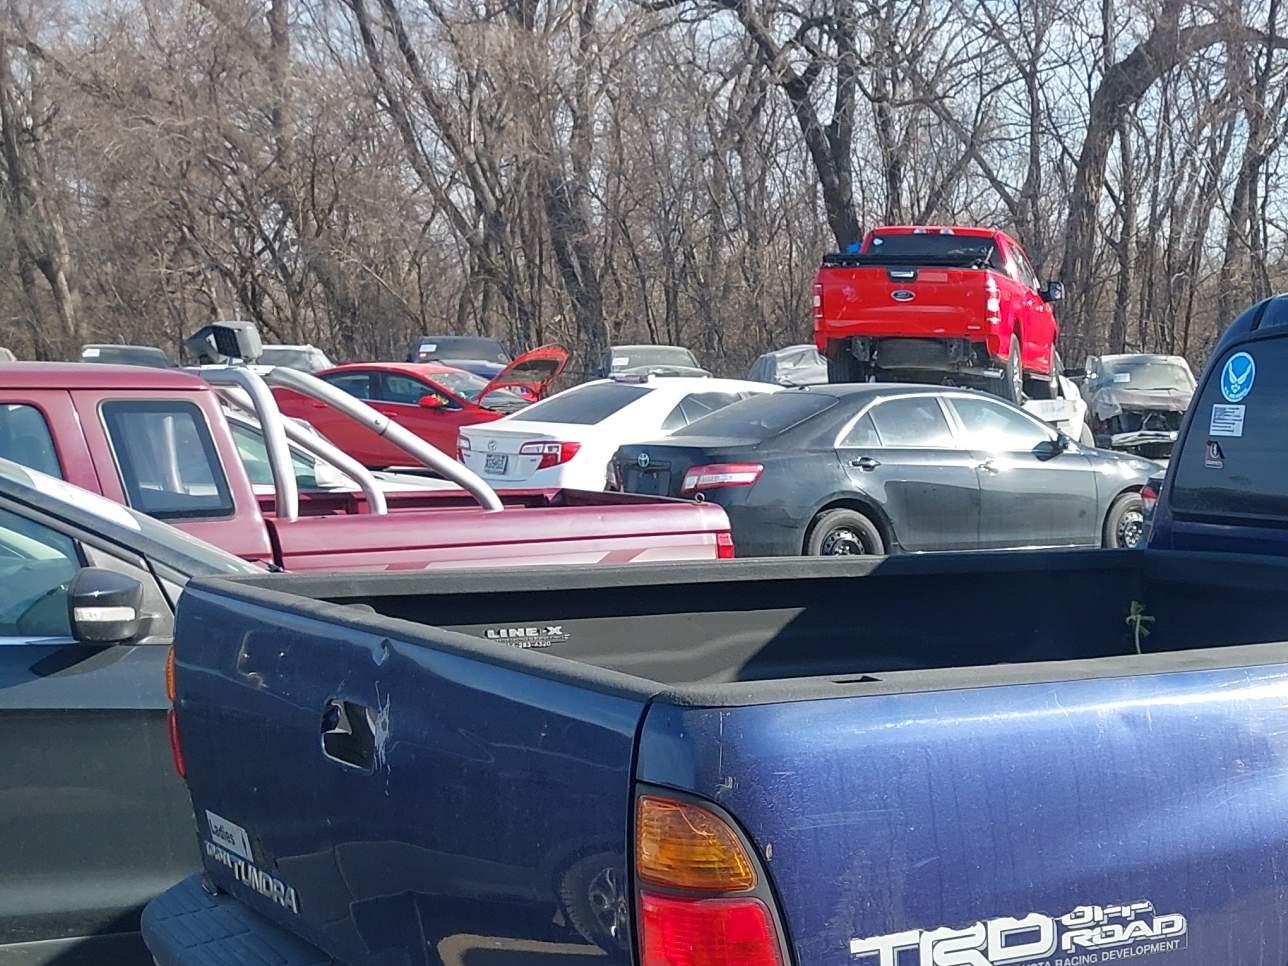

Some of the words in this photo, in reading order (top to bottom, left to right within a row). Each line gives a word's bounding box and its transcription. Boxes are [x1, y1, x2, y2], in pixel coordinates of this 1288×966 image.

[485, 626, 563, 639] LINE-X
[231, 856, 299, 914] TUNDRA
[1061, 900, 1154, 929] OFF
[1061, 912, 1187, 953] ROAD
[1101, 939, 1181, 962] DEVELOPMENT
